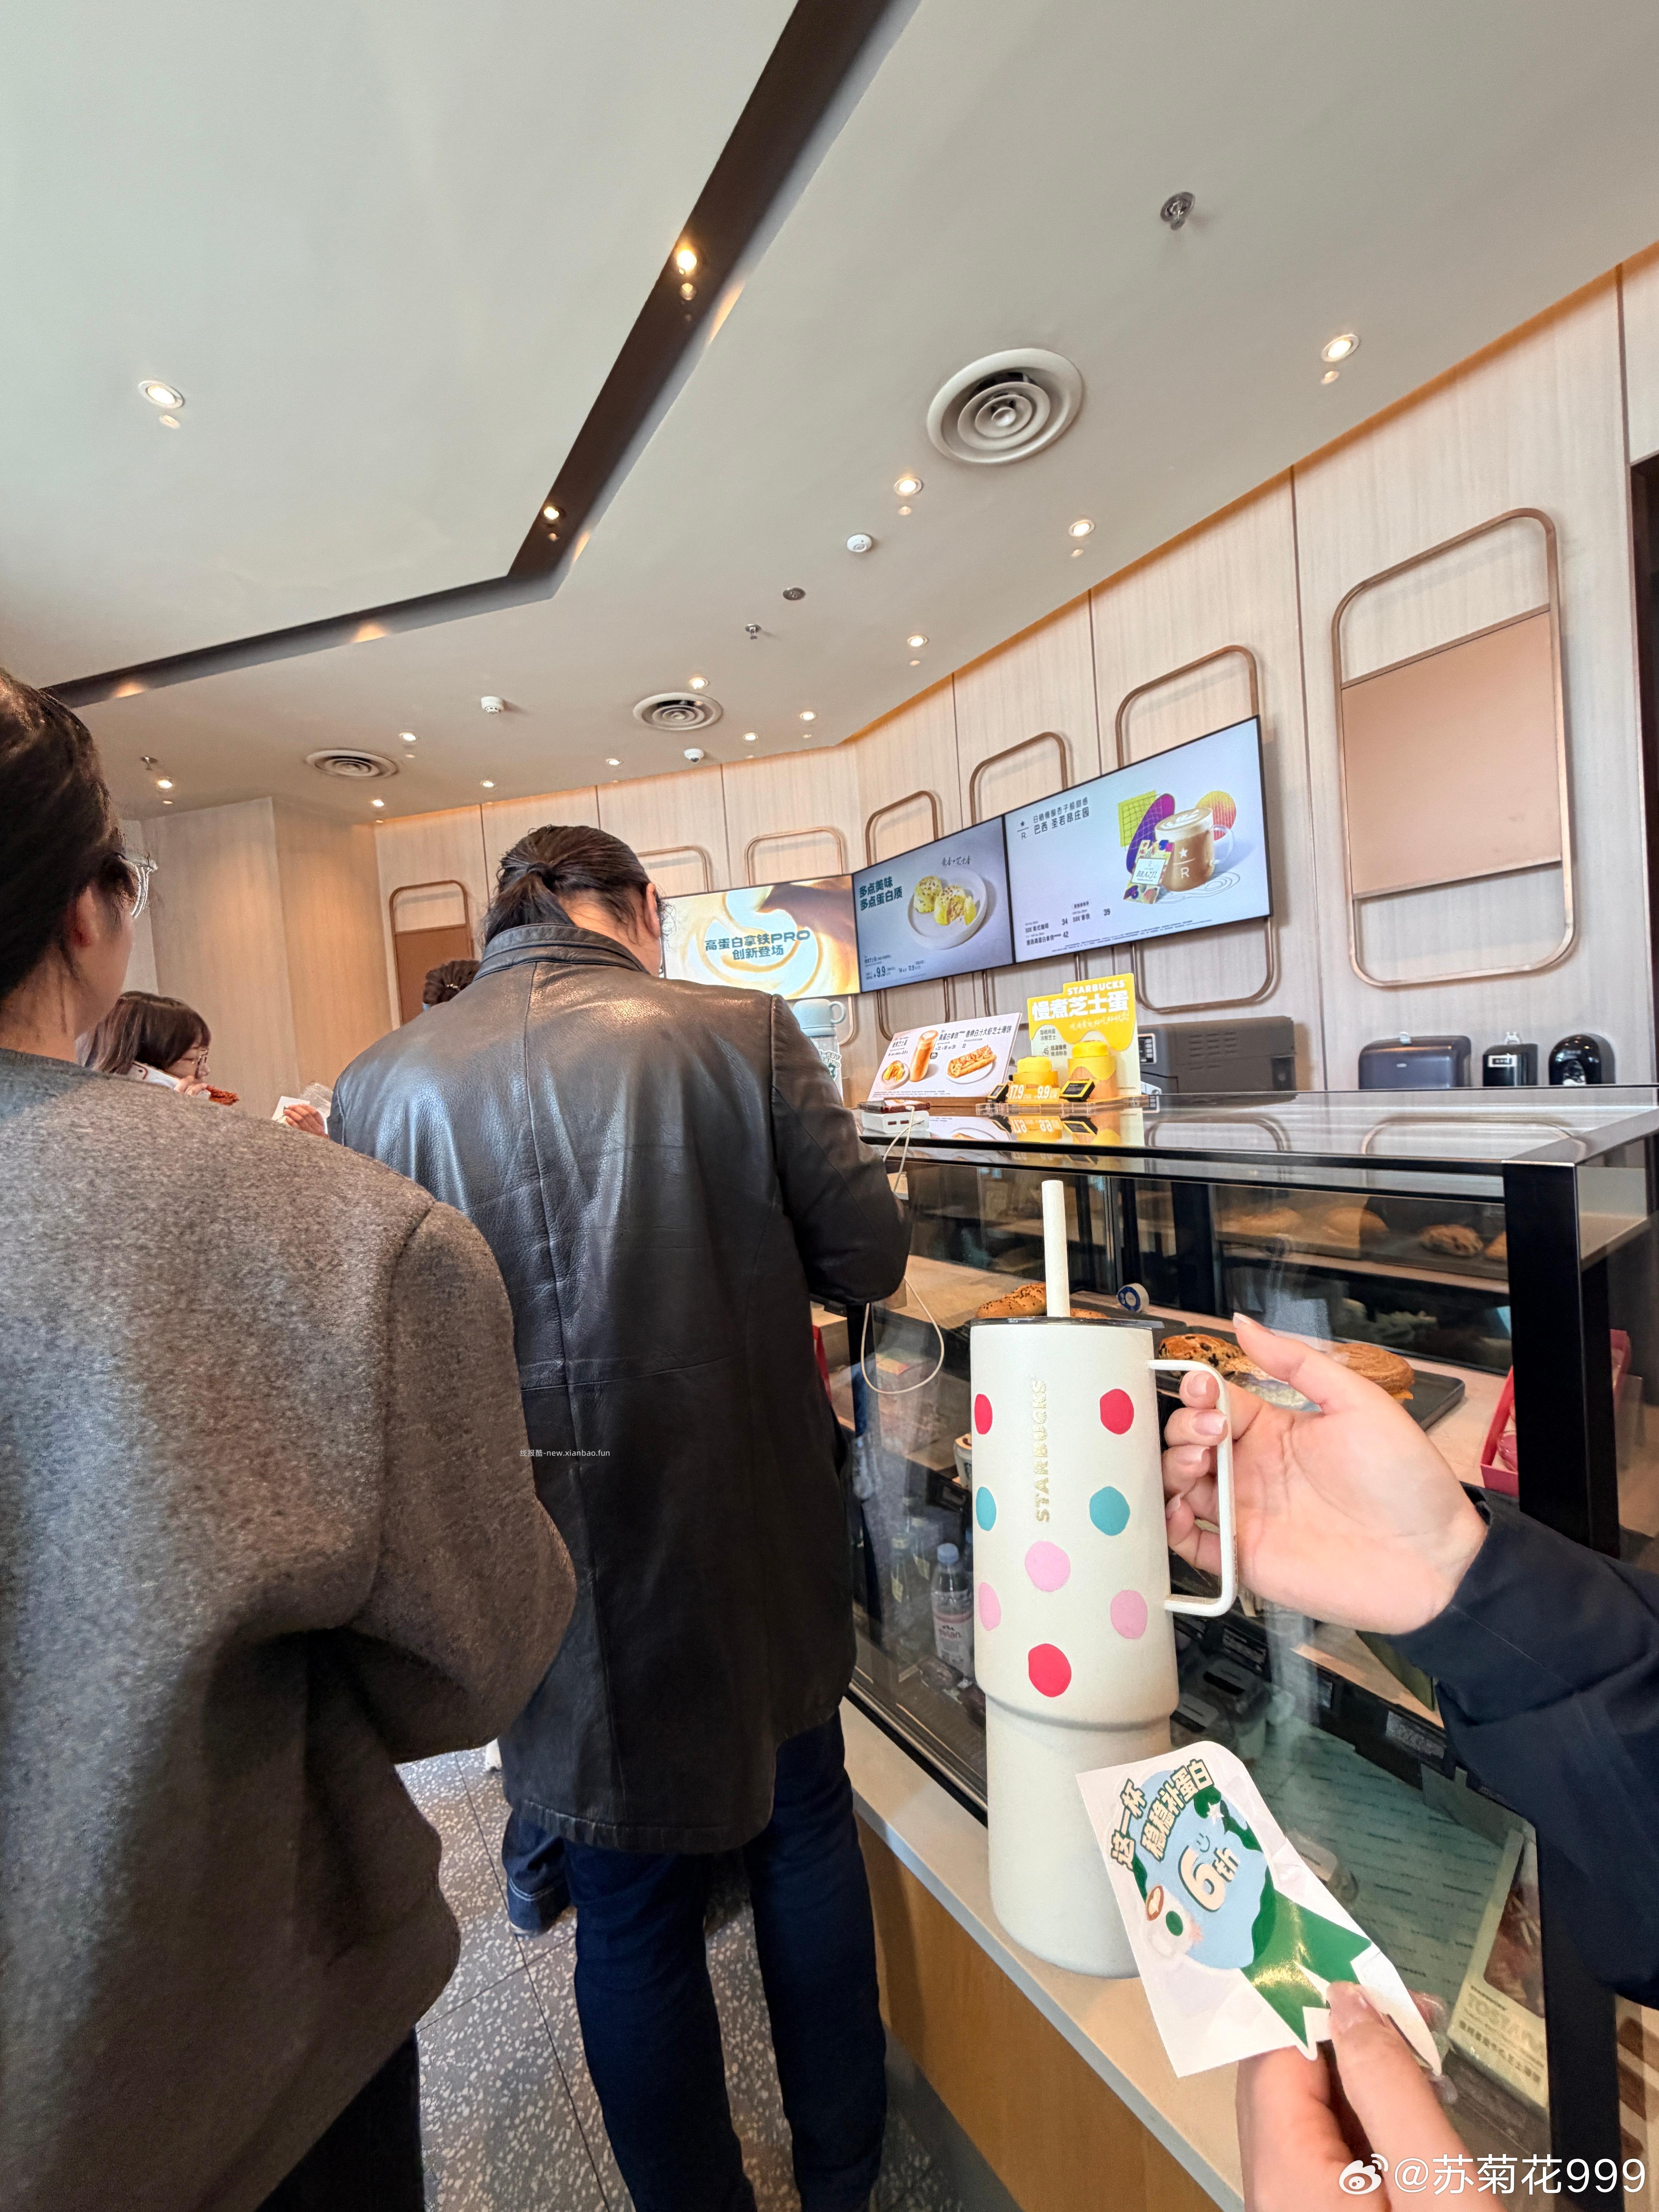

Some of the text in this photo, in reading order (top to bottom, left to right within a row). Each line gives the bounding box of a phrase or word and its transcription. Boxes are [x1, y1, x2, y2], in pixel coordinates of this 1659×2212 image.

[1034, 807, 1089, 835] 巴西 圣若昂庄园
[1136, 870, 1157, 878] BRAZIL
[1181, 867, 1190, 879] R
[859, 876, 893, 898] 多点美味
[860, 886, 903, 911] 多点蛋白质
[1104, 908, 1111, 916] 39
[705, 930, 811, 951] 高蛋白拿铁PRO
[732, 945, 784, 960] 创新登场
[873, 966, 886, 978] +9.9
[1067, 980, 1125, 996] STARBUCKS
[1032, 990, 1129, 1021] 慢煮芝士蛋
[1009, 1084, 1024, 1099] 17.9
[1032, 1375, 1050, 1523] STARBUCKS
[1140, 1759, 1214, 1862] 稳稳补蛋白
[1111, 1778, 1147, 1872] 这一杯
[1178, 1848, 1240, 1912] 6th
